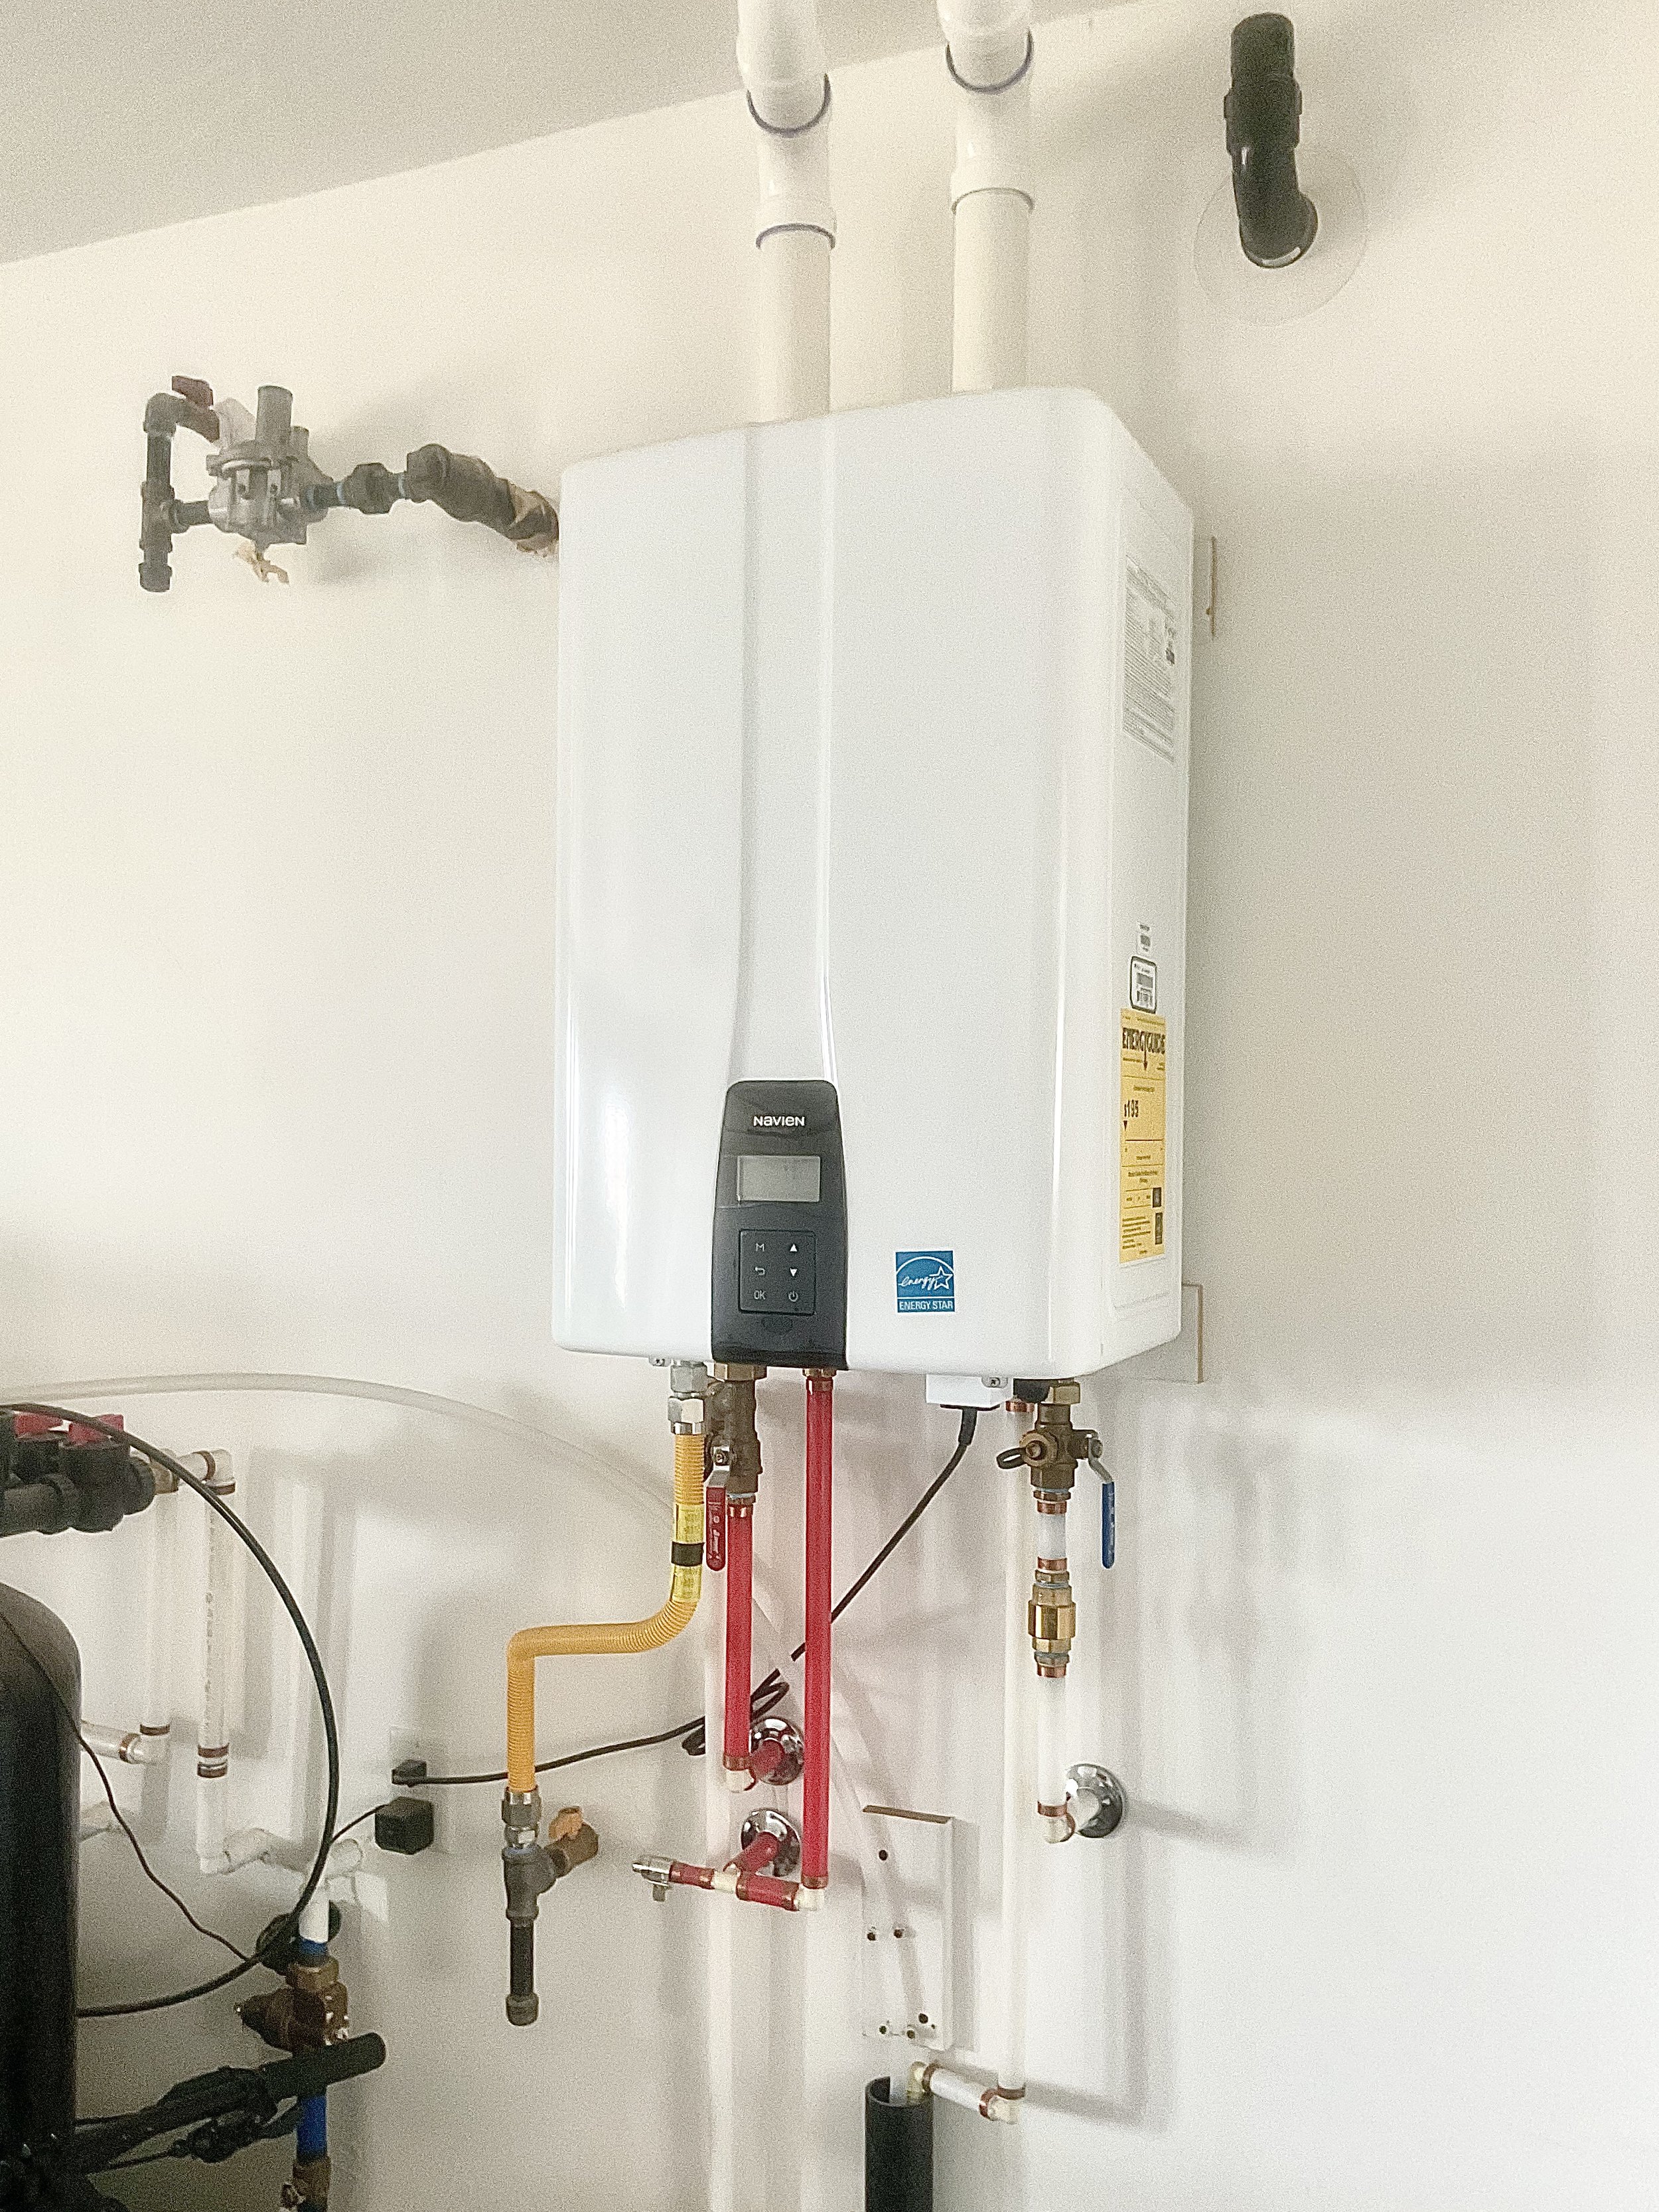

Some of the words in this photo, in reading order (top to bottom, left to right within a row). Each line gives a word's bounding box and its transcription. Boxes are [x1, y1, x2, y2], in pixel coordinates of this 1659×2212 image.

[755, 1242, 765, 1252] M
[753, 1290, 766, 1300] OK
[899, 1300, 931, 1311] ENERGY
[932, 1300, 954, 1310] STAR
